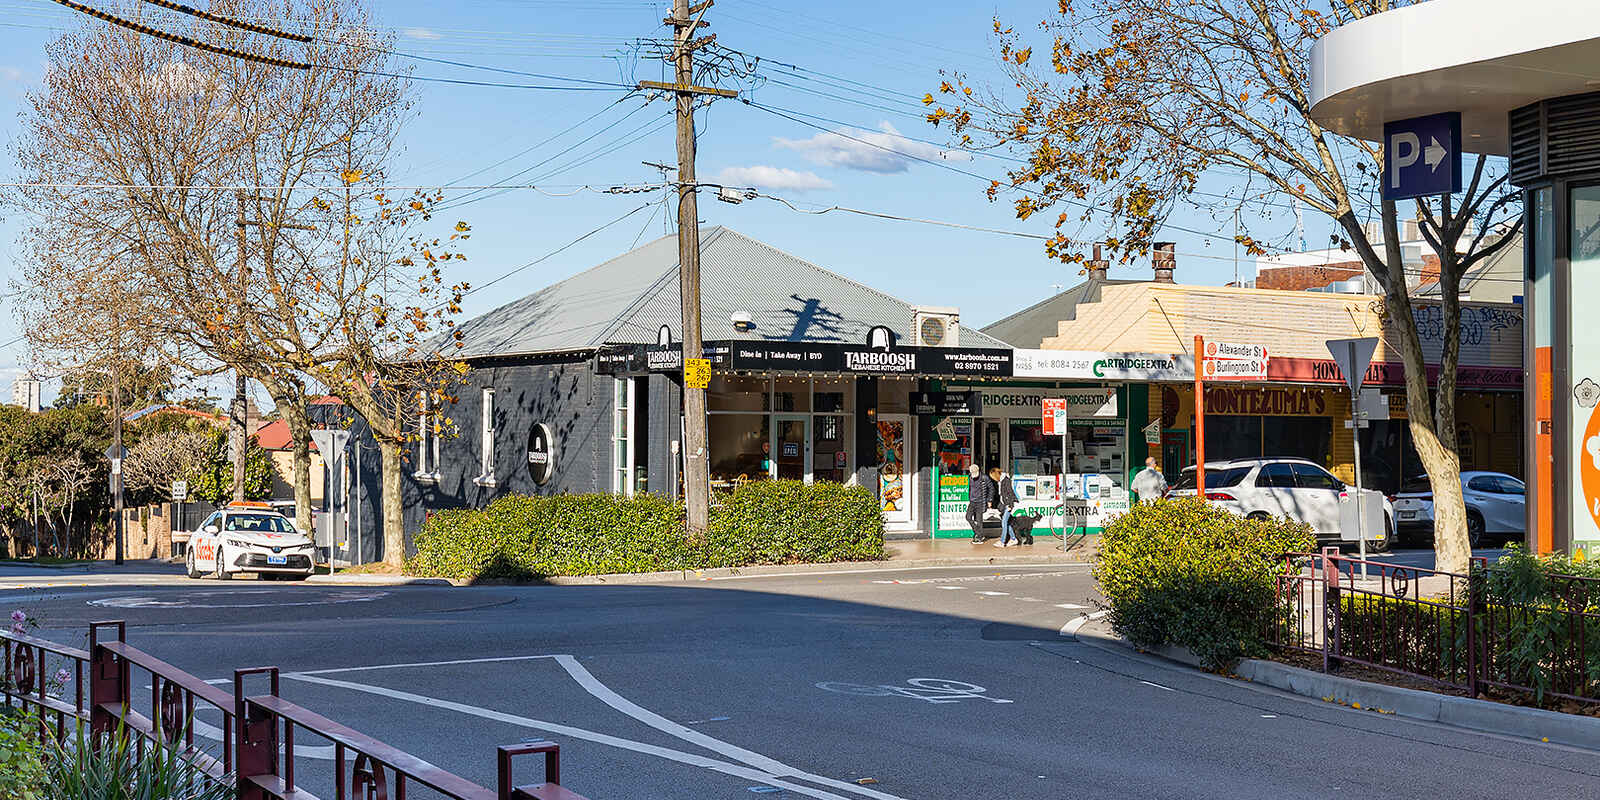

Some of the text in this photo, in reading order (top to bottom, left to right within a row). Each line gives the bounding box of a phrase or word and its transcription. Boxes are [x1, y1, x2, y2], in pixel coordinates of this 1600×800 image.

[1391, 131, 1420, 188] P
[770, 351, 785, 359] Take
[786, 351, 801, 360] Away
[1219, 343, 1261, 357] Alexander St
[844, 351, 916, 370] TARBOOSH
[965, 362, 982, 370] 8970
[1050, 360, 1070, 369] 8084
[1072, 361, 1089, 369] 2567
[1092, 358, 1175, 377] CARTRIDGEEXTRA
[1217, 360, 1258, 374] Burlington St
[940, 503, 967, 512] RINTER
